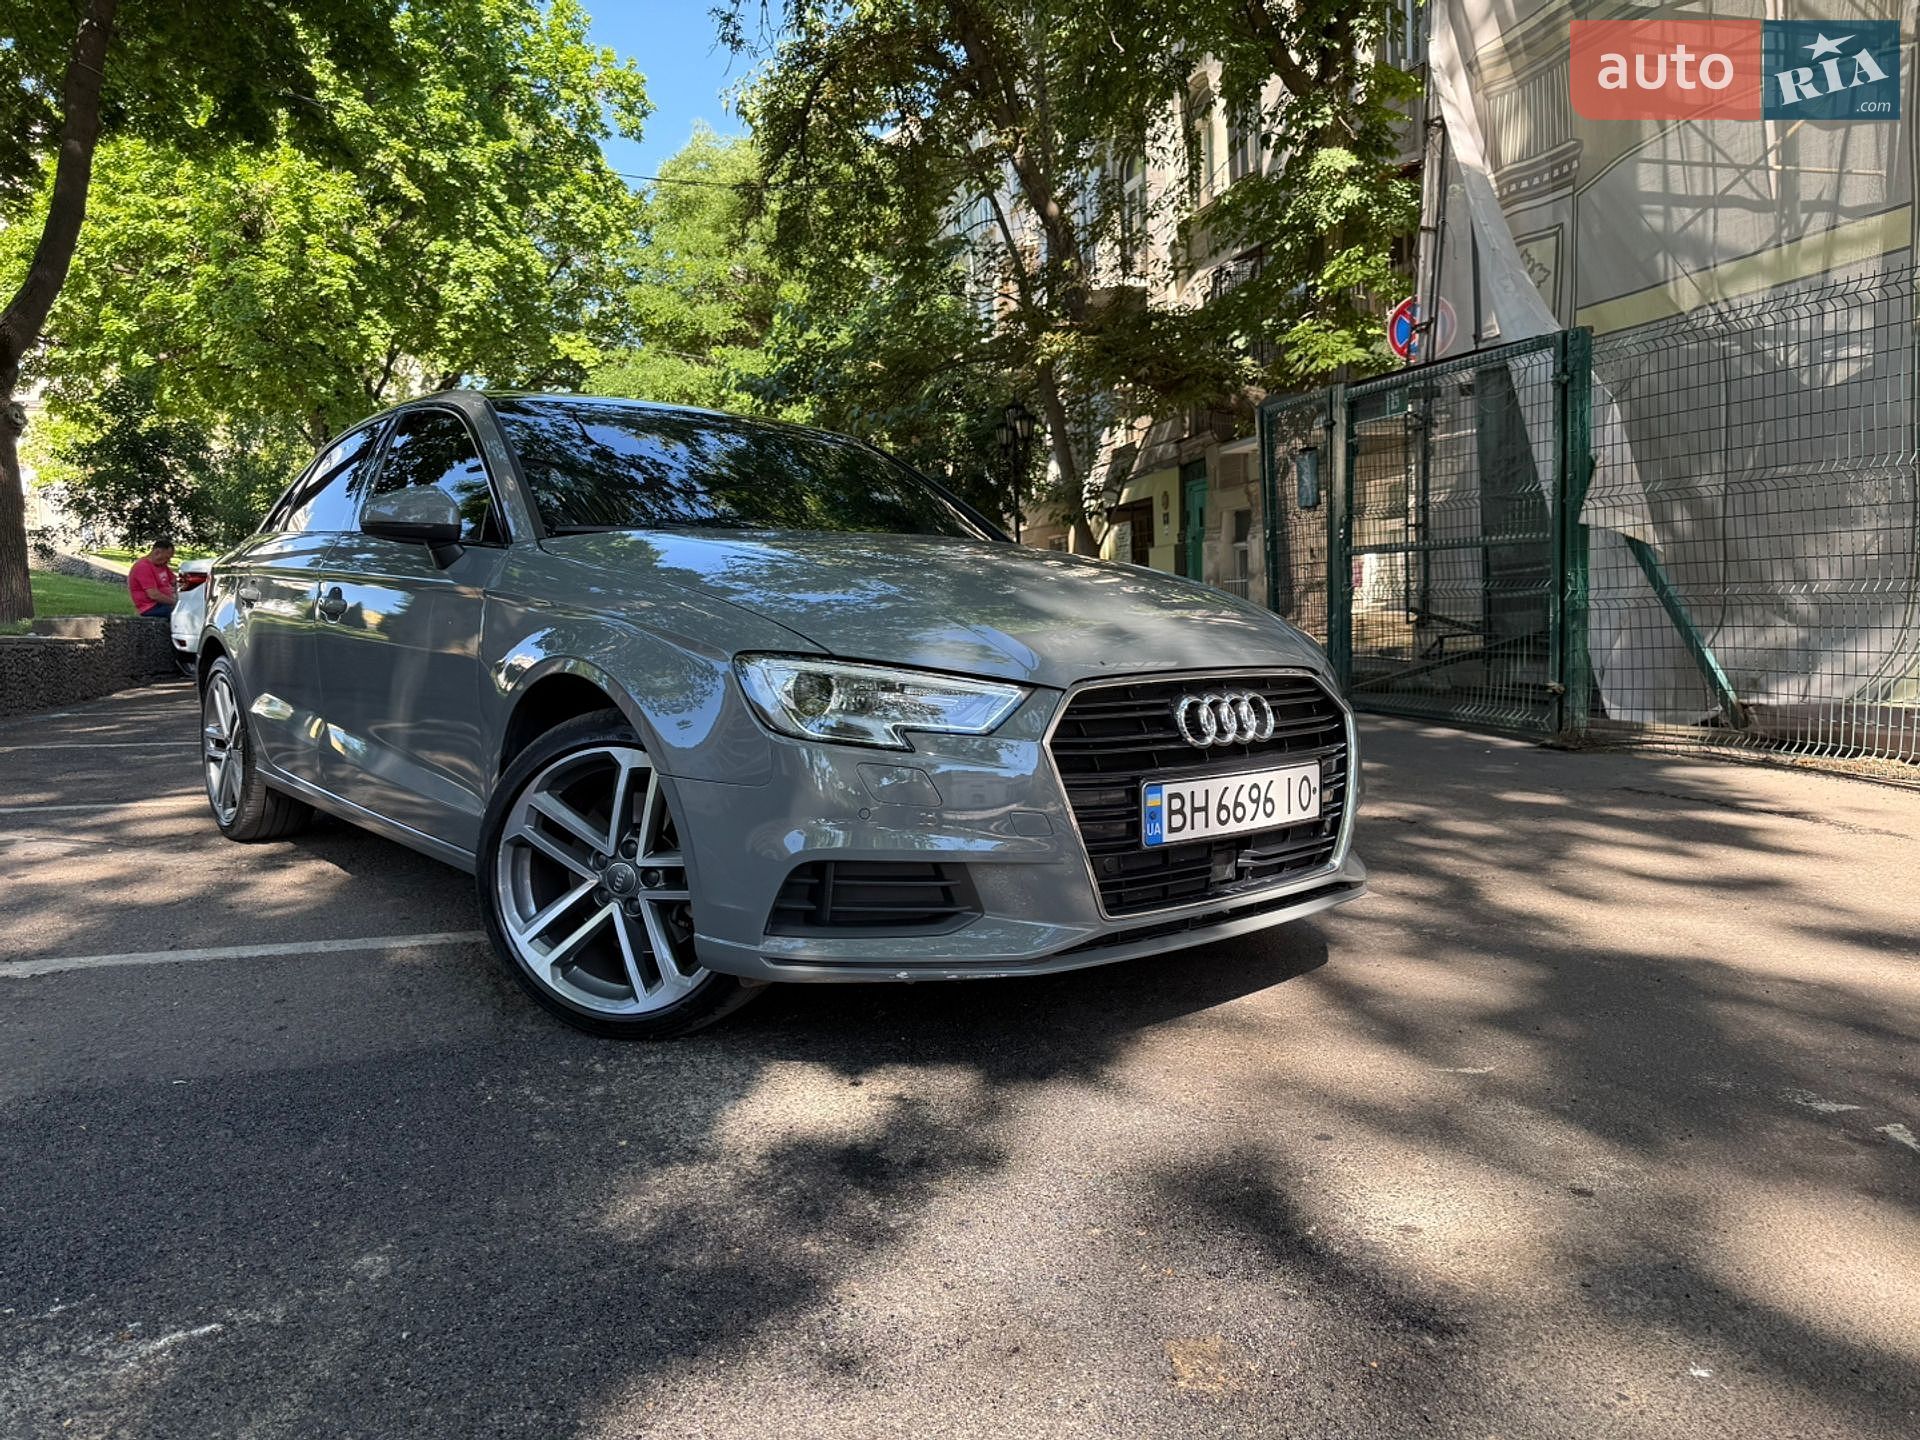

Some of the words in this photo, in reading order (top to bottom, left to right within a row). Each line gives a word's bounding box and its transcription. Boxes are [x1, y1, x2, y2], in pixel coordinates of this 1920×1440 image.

[1166, 788, 1209, 834] BH
[1216, 779, 1276, 827] 6696
[1146, 823, 1161, 836] UA
